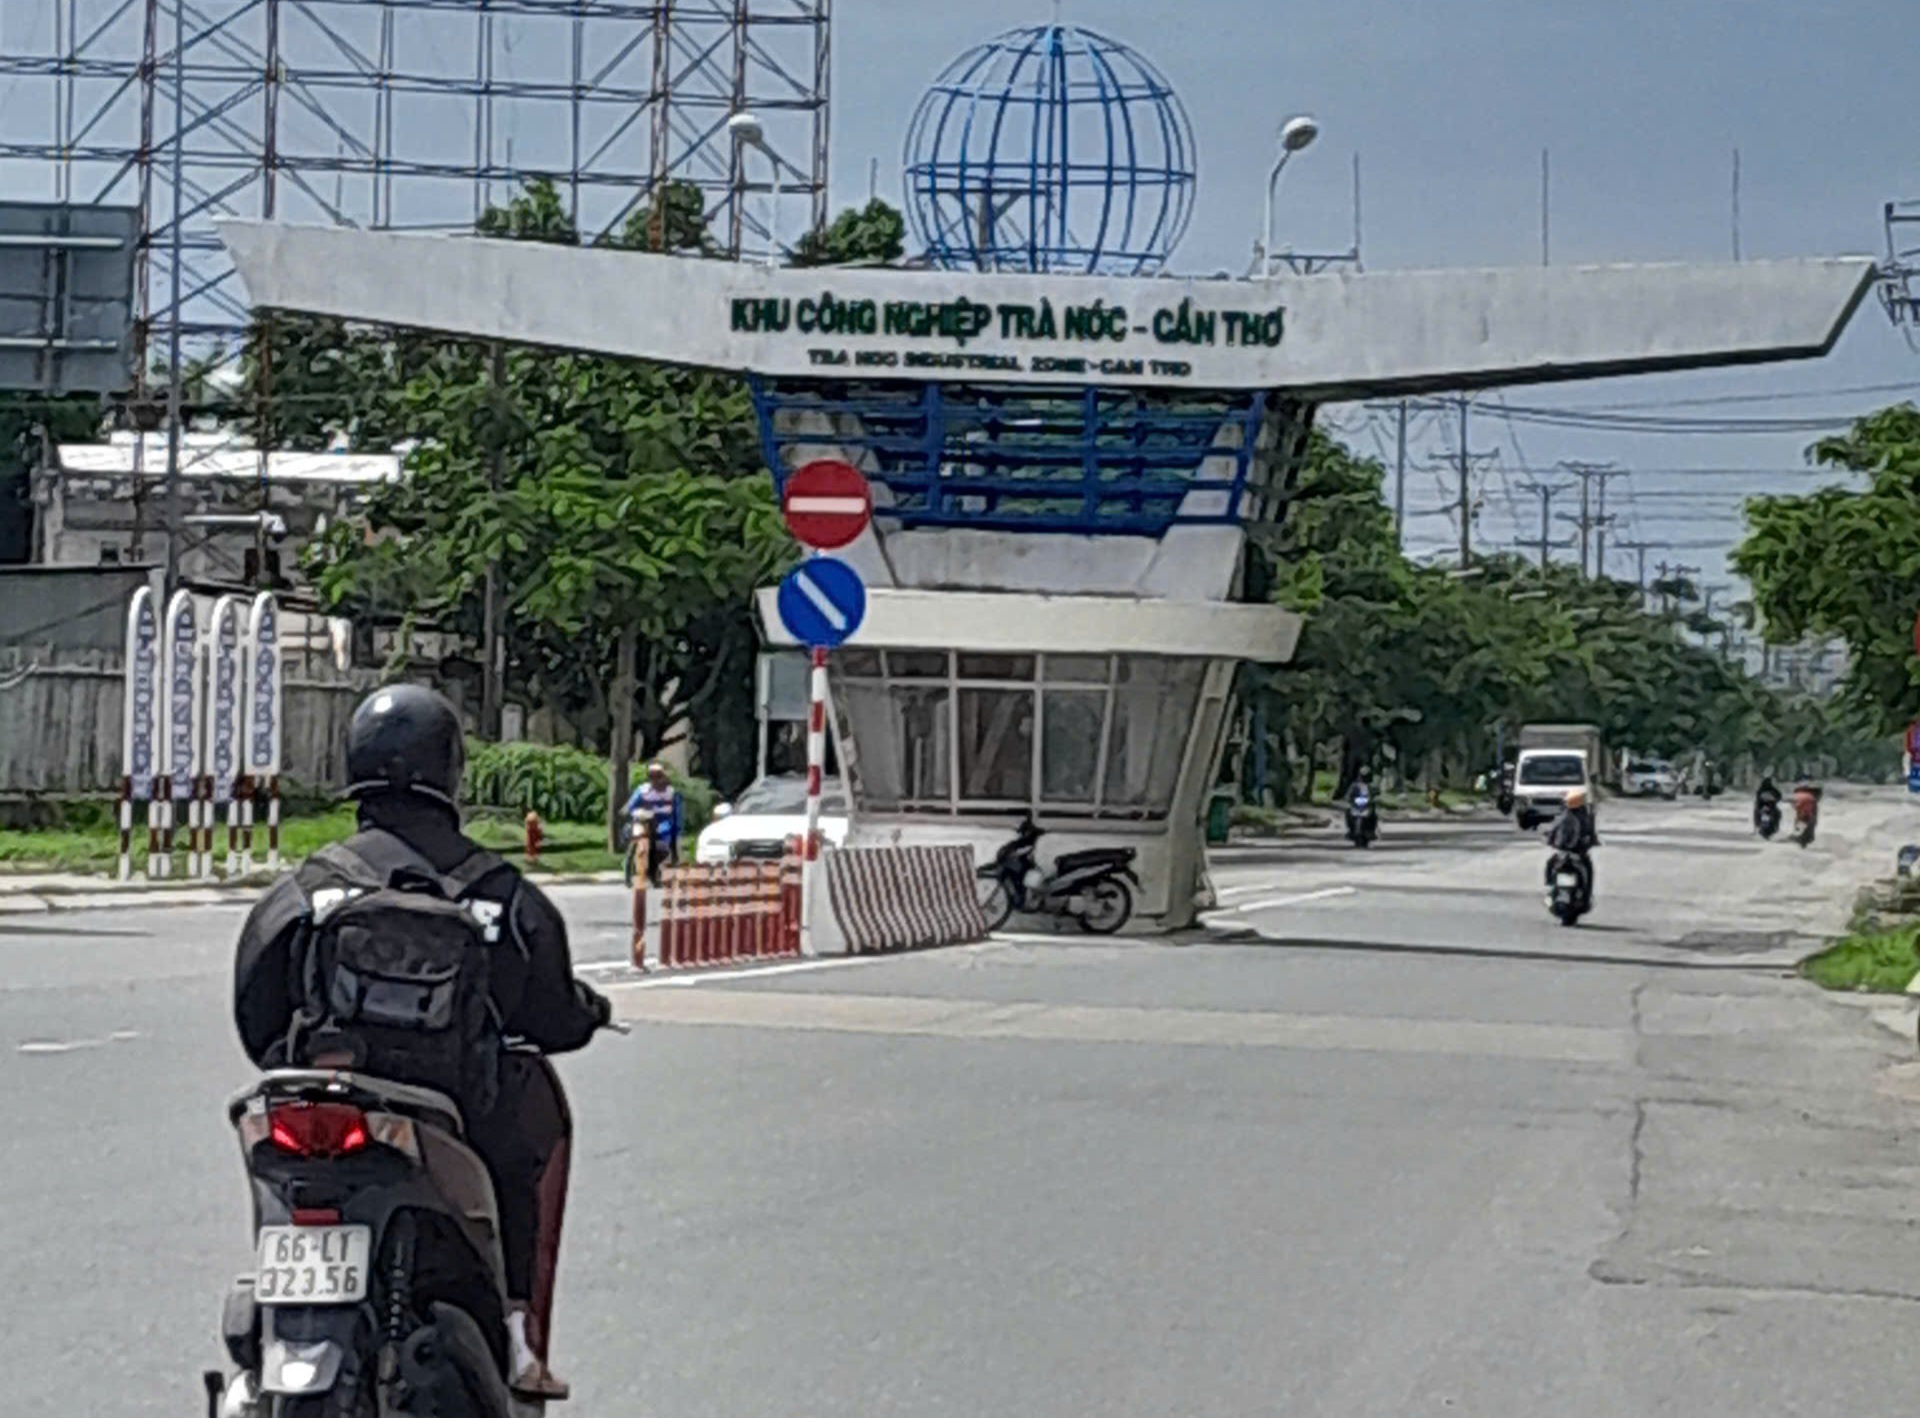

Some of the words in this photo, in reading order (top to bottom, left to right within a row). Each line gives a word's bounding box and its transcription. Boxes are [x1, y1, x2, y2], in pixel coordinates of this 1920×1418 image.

[731, 298, 790, 332] KHU
[797, 291, 876, 334] CÔNG
[884, 296, 992, 347] NGHIỆP
[997, 296, 1057, 340] TRÀ
[1065, 298, 1127, 342] NÓC
[1221, 305, 1287, 347] THƠ
[808, 349, 849, 366] TRA
[903, 351, 1024, 371] INDUSTRIAL
